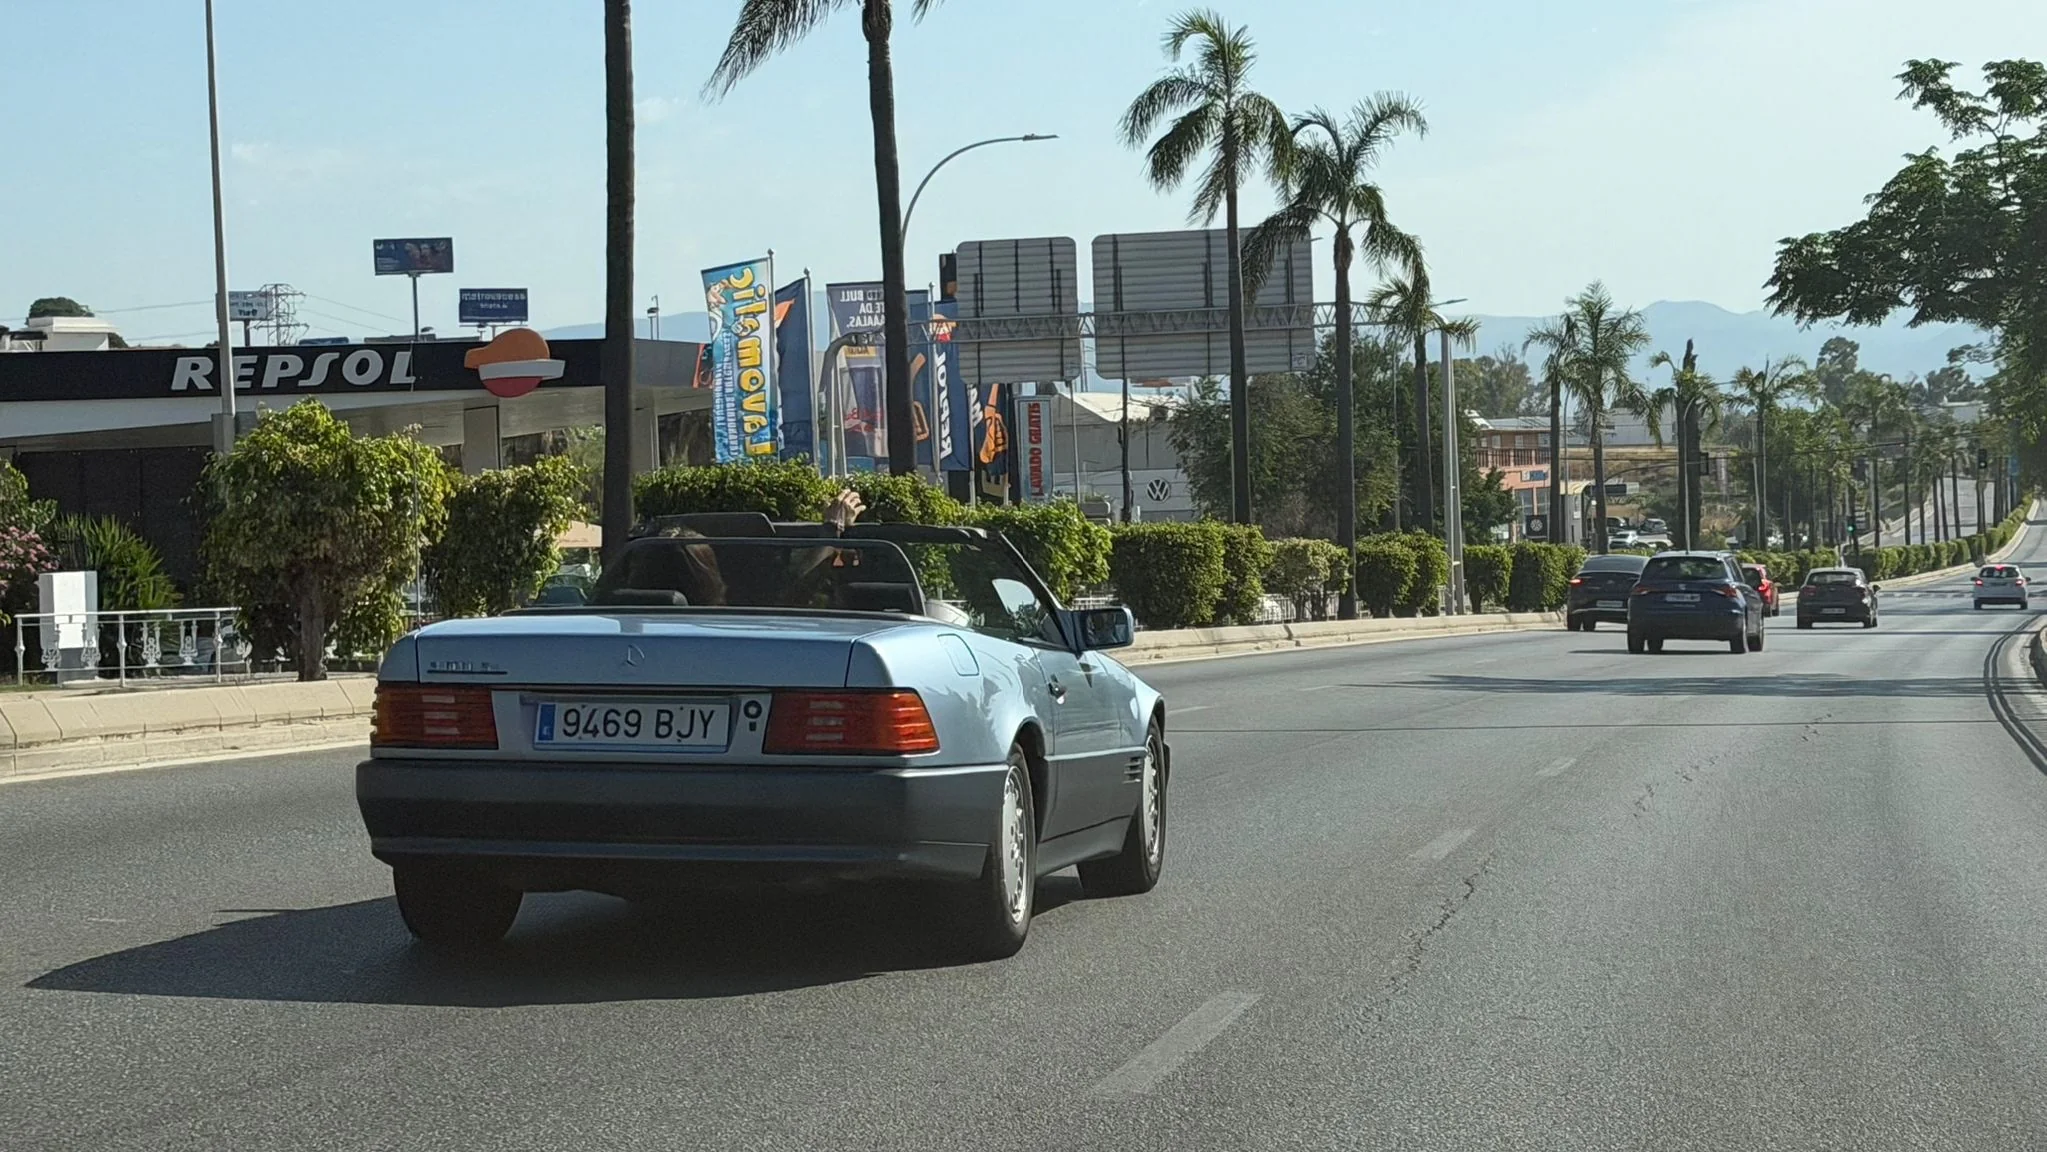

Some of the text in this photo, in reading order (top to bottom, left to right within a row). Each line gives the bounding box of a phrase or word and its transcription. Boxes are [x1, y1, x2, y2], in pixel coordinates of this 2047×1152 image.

[170, 349, 416, 391] REPSOL
[562, 708, 715, 739] 9469 BJY
